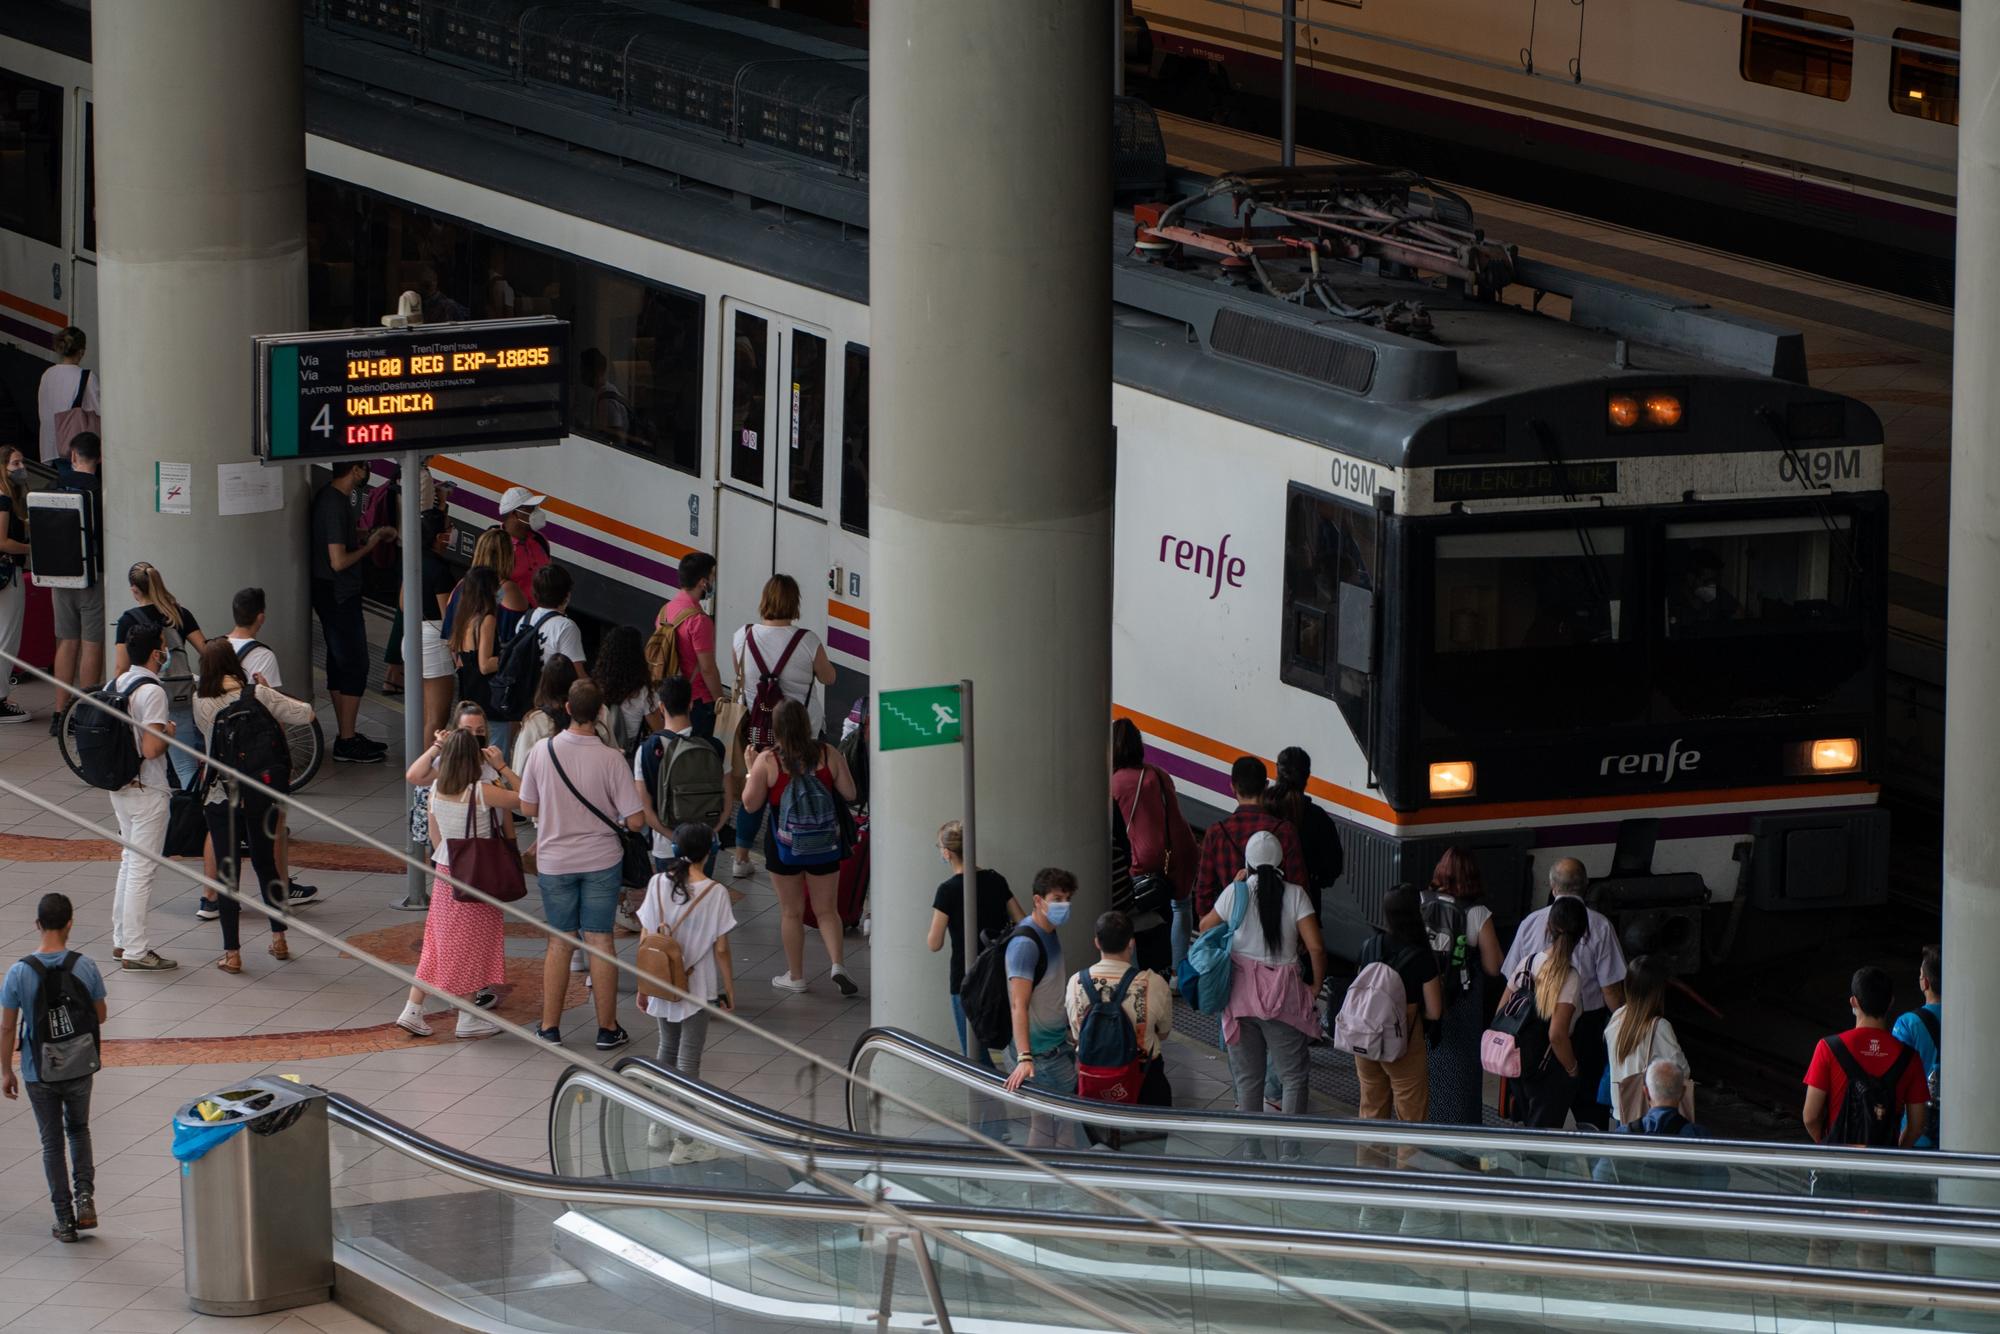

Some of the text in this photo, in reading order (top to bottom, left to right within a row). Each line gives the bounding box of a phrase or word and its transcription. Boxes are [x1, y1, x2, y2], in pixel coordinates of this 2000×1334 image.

[347, 347, 549, 379] 14:00 REG EXP-18095
[301, 385, 342, 396] PLATFORM
[346, 394, 434, 416] VALENCIA
[310, 403, 334, 438] 4
[1331, 458, 1376, 496] 019M
[1779, 449, 1861, 482] 019M
[1160, 533, 1246, 599] renfe
[1599, 737, 1702, 784] renfe
